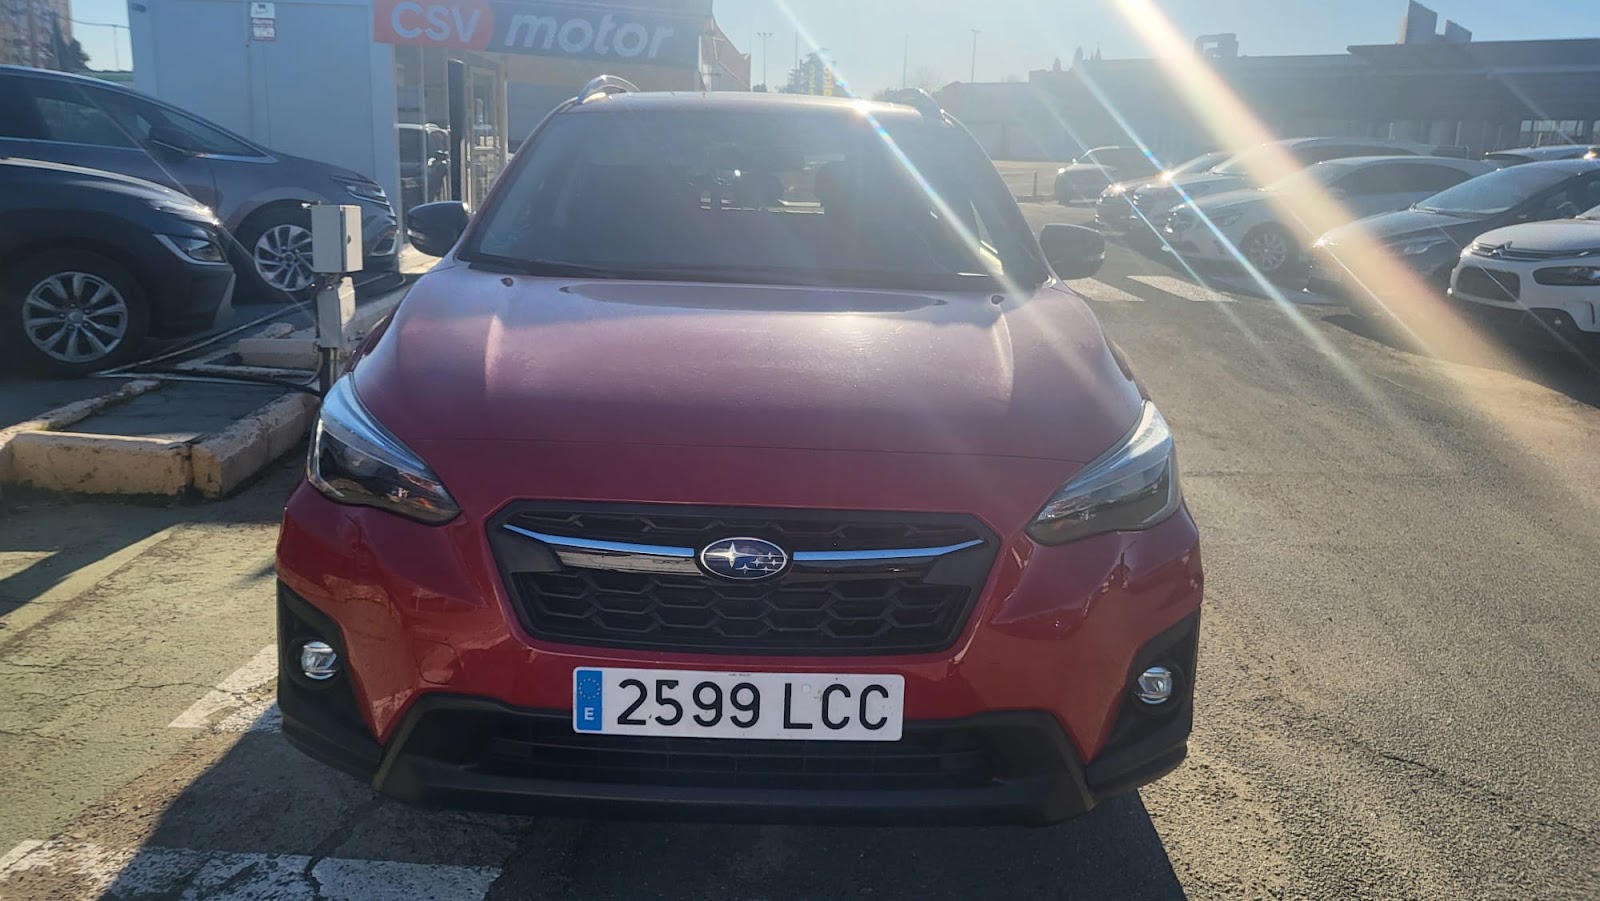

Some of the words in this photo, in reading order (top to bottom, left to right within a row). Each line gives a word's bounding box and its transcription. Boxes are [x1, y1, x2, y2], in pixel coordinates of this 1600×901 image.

[391, 2, 480, 43] CSV
[505, 14, 674, 57] motor
[584, 707, 595, 720] E
[617, 679, 761, 728] 2599
[783, 683, 889, 730] LCC
